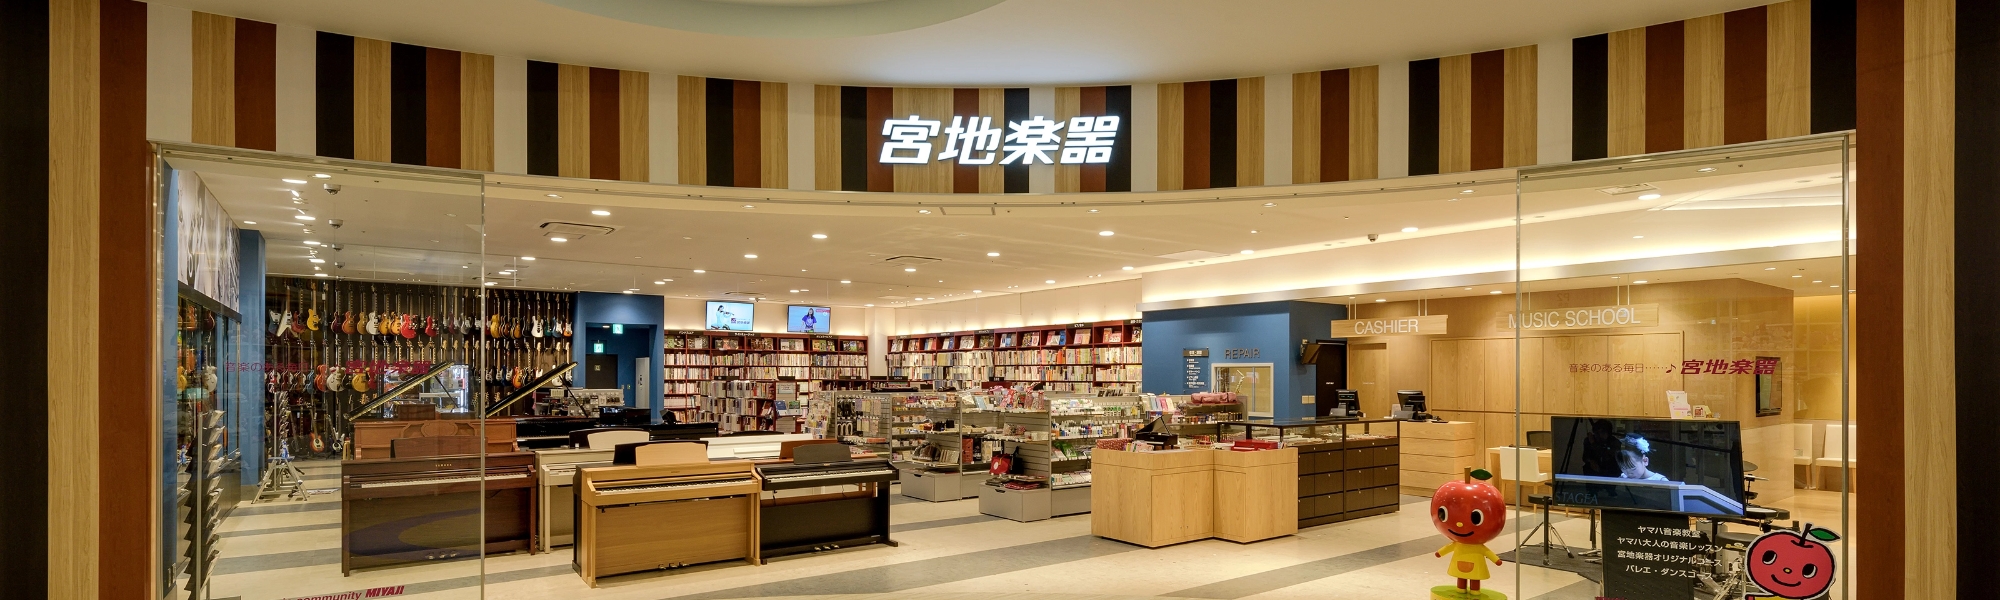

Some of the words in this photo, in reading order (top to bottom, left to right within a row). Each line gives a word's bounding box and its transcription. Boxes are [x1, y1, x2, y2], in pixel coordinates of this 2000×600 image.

[879, 115, 1120, 164] 宮地楽器
[1354, 318, 1419, 335] CASHIER
[1508, 311, 1560, 329] MUSIC
[1565, 307, 1641, 327] SCHOOL
[1224, 348, 1260, 359] REPAIR
[1680, 359, 1778, 375] 宮地楽器
[1638, 525, 1701, 538] ヤマハ音楽教室
[1617, 536, 1723, 553] ヤマハ大人の音楽レッスン
[1617, 550, 1723, 567] 宮地楽器オリジナルコース
[365, 585, 405, 598] MIYAJI
